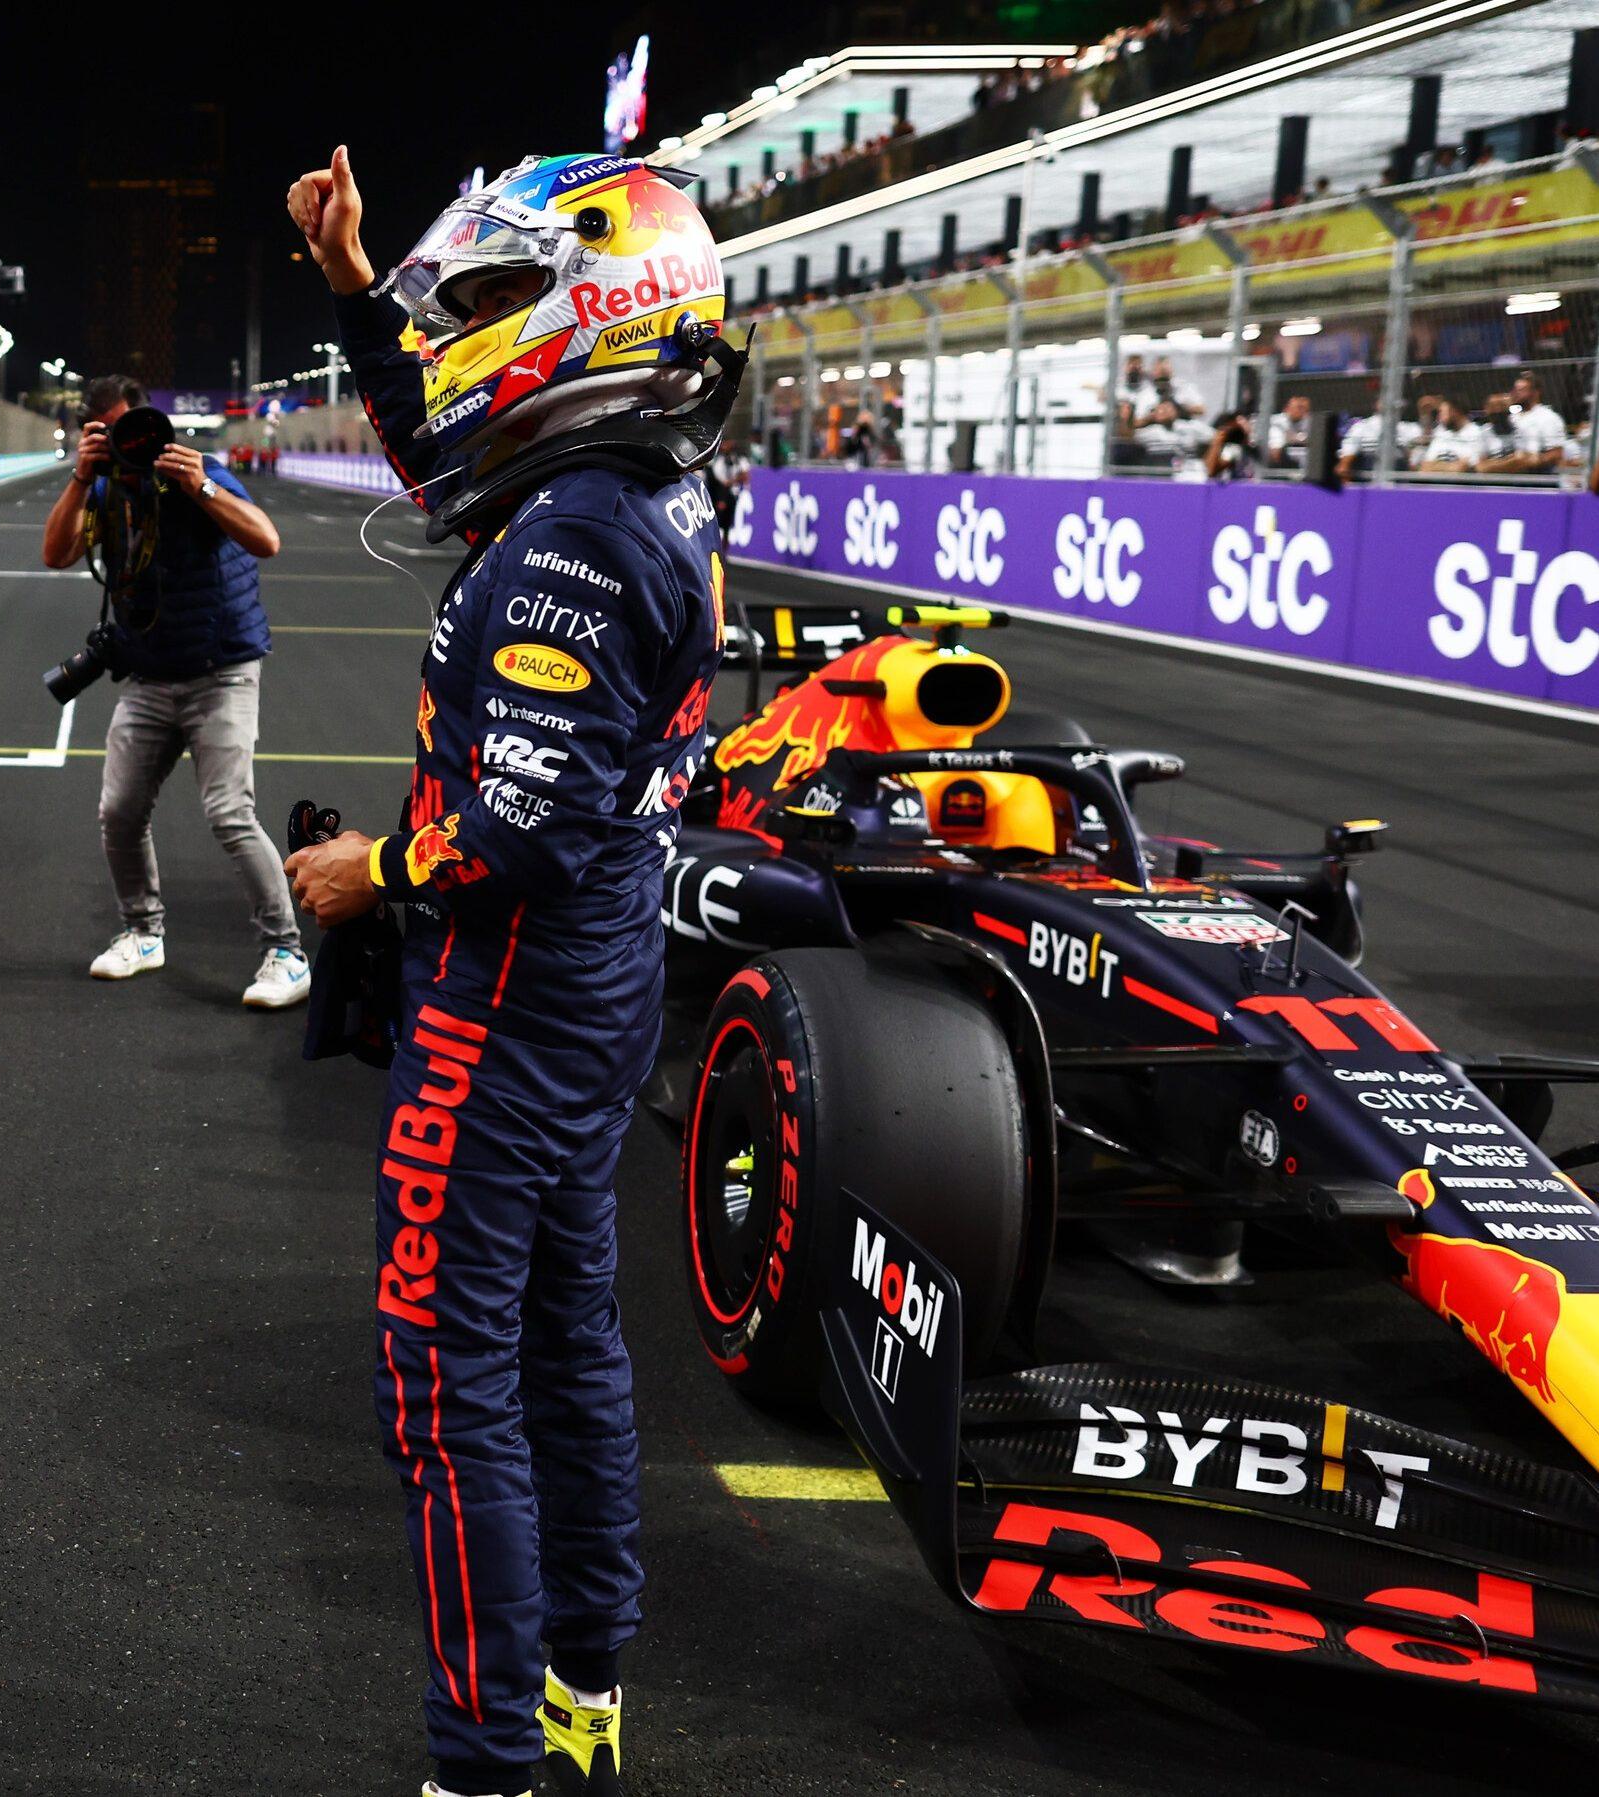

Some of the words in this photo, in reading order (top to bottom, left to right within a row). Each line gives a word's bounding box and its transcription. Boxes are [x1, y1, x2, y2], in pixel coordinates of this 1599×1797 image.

[569, 259, 661, 330] Red
[661, 243, 719, 299] Bull
[604, 319, 655, 350] KAVAK
[772, 481, 818, 557] stc
[843, 484, 900, 570] stc
[934, 489, 1006, 587] stc
[523, 547, 624, 596] infinitum
[1052, 497, 1145, 607] stc
[1208, 505, 1334, 635] stc
[506, 592, 608, 649] citrix
[1428, 519, 1599, 676] stc
[516, 653, 580, 686] RAUCH
[509, 703, 577, 734] inter.mx
[483, 733, 570, 779] HRC
[505, 766, 556, 783] RACING
[493, 797, 542, 831] WOLF
[496, 781, 554, 817] ARCTIC
[1028, 921, 1119, 998] BYBIT
[1236, 996, 1442, 1052] 11
[1333, 1069, 1396, 1083] Cash
[1399, 1070, 1448, 1086] App
[1412, 1118, 1506, 1135] Tezos
[1452, 1144, 1529, 1157] ARCTIC
[1468, 1156, 1529, 1168] WOLF
[767, 1115, 799, 1302] ZERO
[1460, 1200, 1593, 1215] infinitum
[1483, 1222, 1587, 1240] Mobil
[852, 1216, 945, 1358] Mobil
[1071, 1403, 1430, 1529] BYBIT
[971, 1501, 1539, 1694] Red
